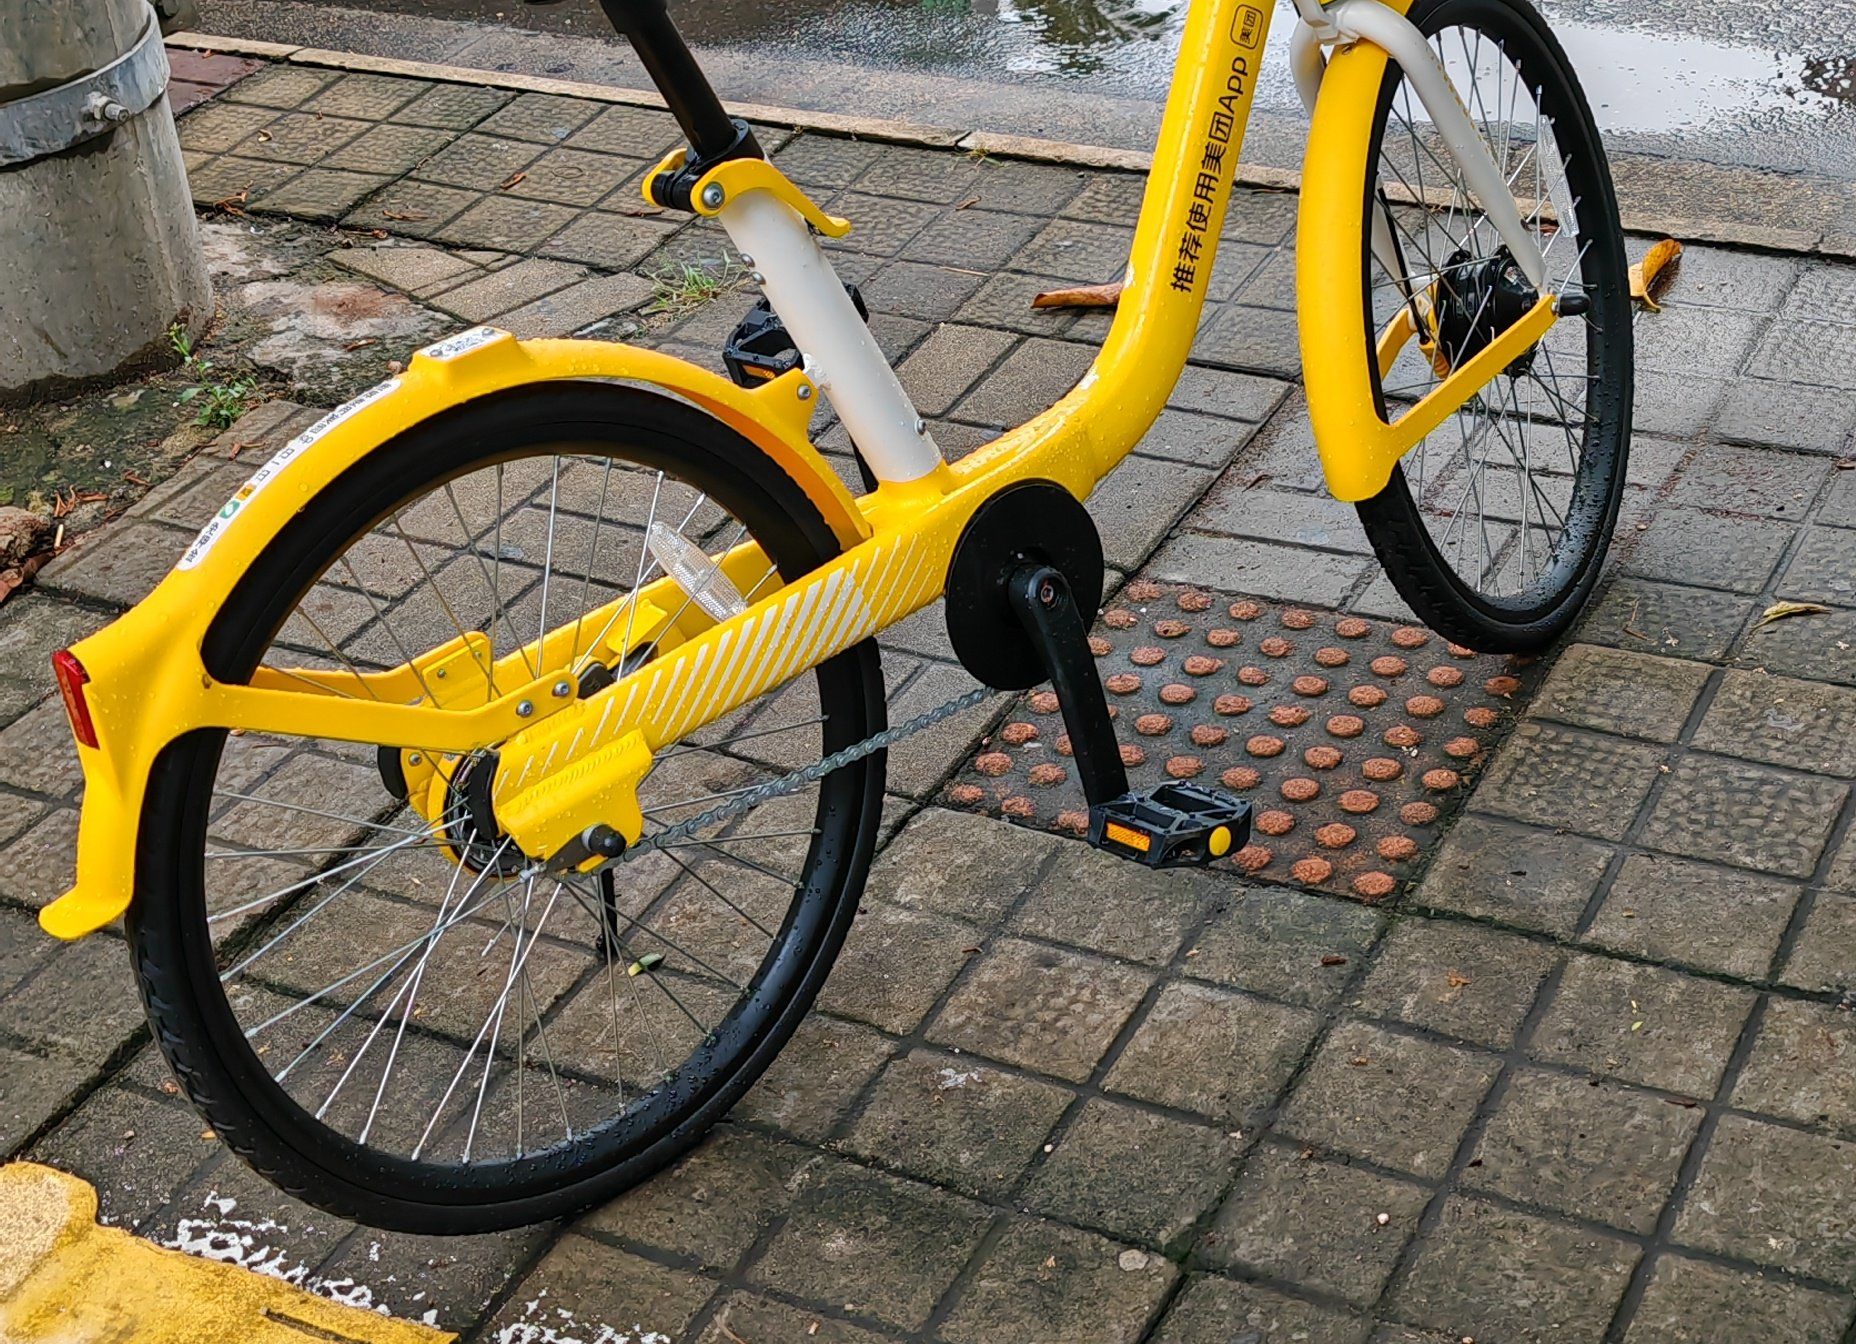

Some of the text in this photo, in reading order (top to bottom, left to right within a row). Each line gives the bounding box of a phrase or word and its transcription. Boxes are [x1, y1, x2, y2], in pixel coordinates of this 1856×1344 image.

[1170, 10, 1257, 293] 推荐使用美团App 美团
